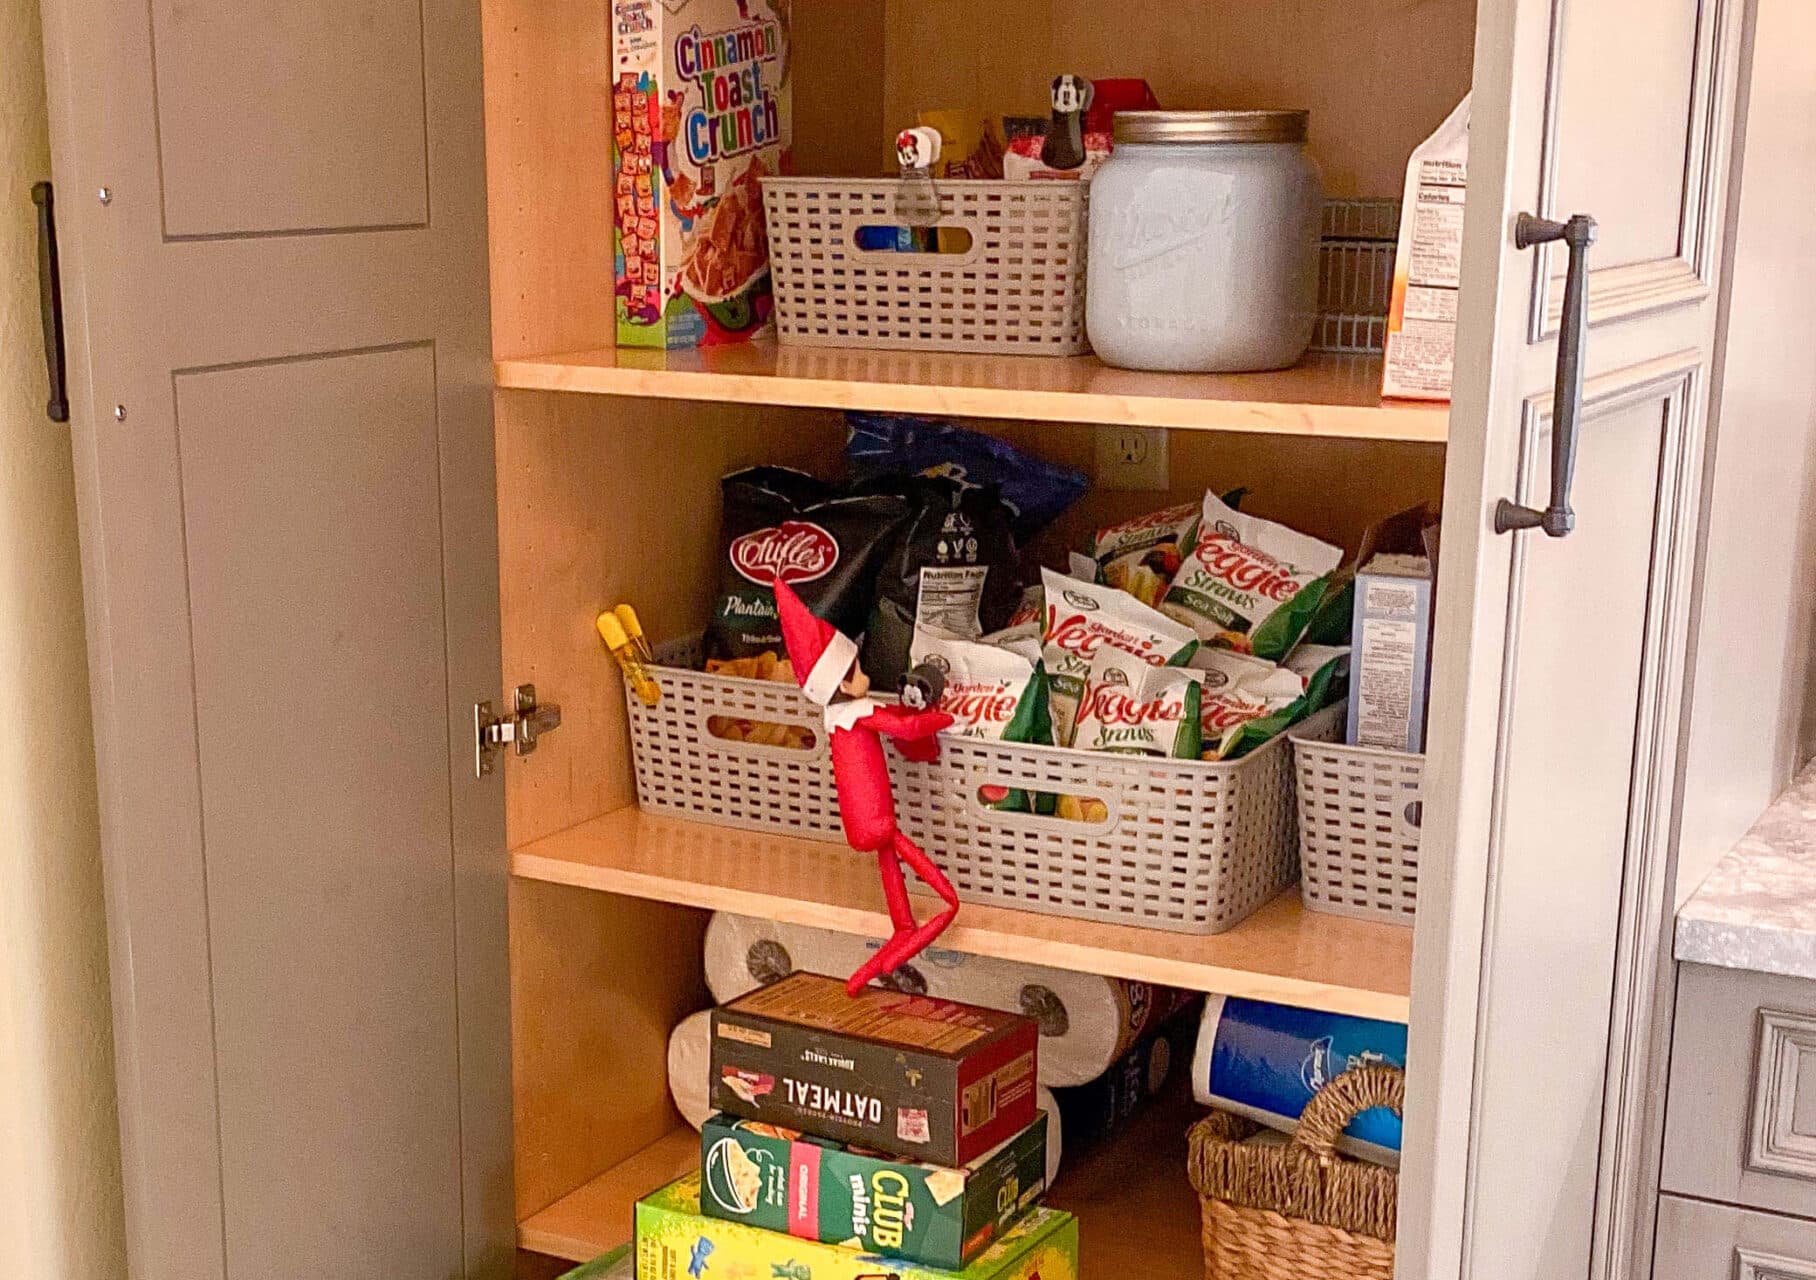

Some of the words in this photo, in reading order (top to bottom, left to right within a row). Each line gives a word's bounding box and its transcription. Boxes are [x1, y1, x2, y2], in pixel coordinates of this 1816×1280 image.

[678, 25, 776, 76] Cinnamon
[701, 61, 763, 114] Toast
[687, 93, 778, 164] Crunch
[1184, 569, 1256, 609] Straws
[783, 1077, 881, 1124] OATMEAL
[797, 1165, 809, 1220] ORIGINAL
[849, 1174, 870, 1236] minis
[872, 1170, 910, 1249] CLUB
